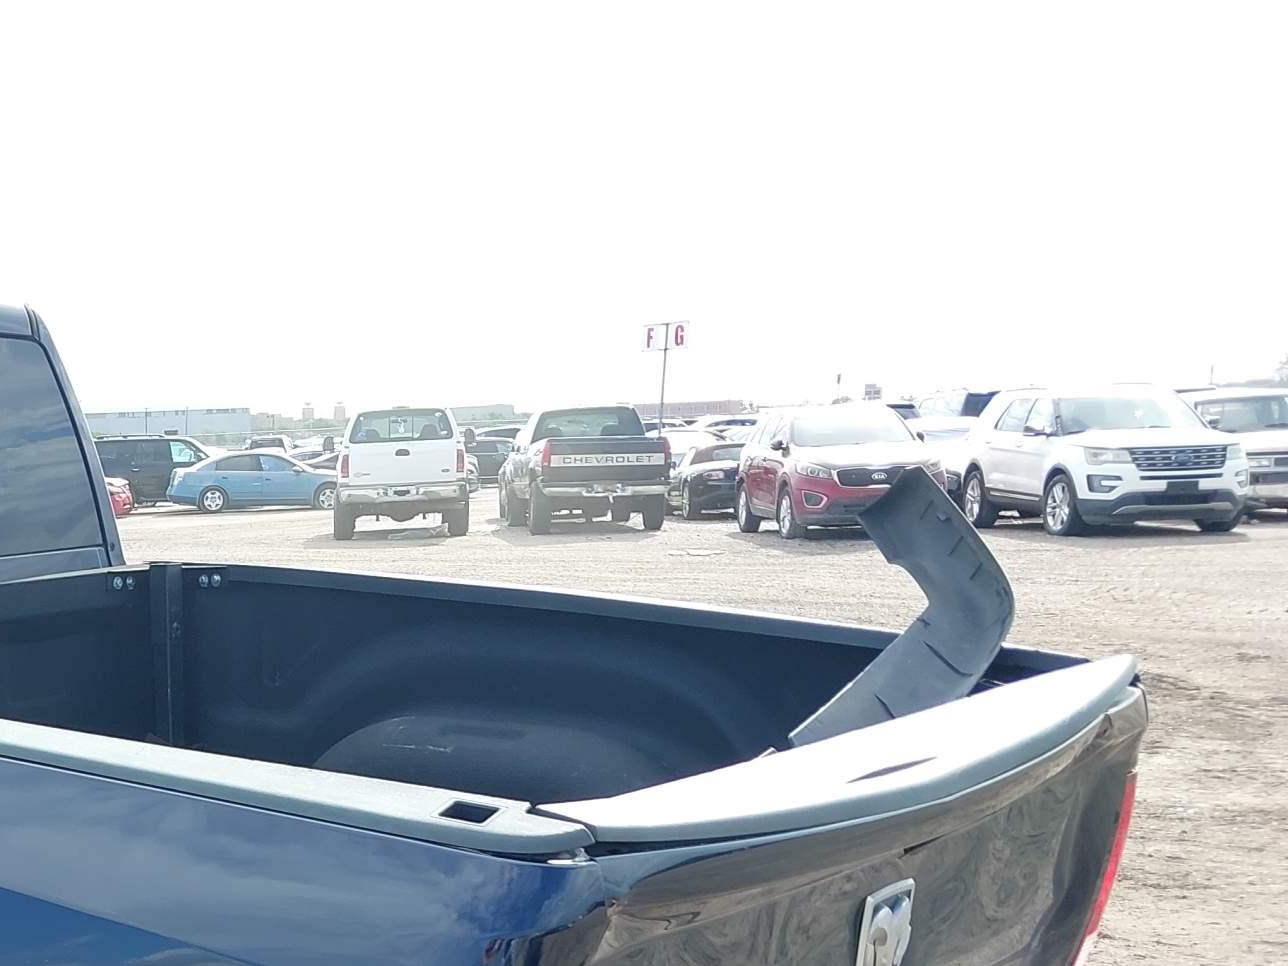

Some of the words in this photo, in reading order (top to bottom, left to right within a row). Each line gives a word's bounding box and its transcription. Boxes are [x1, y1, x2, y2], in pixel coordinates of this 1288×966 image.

[647, 328, 654, 349] F
[675, 324, 684, 346] G
[562, 455, 654, 465] CHEVROLET
